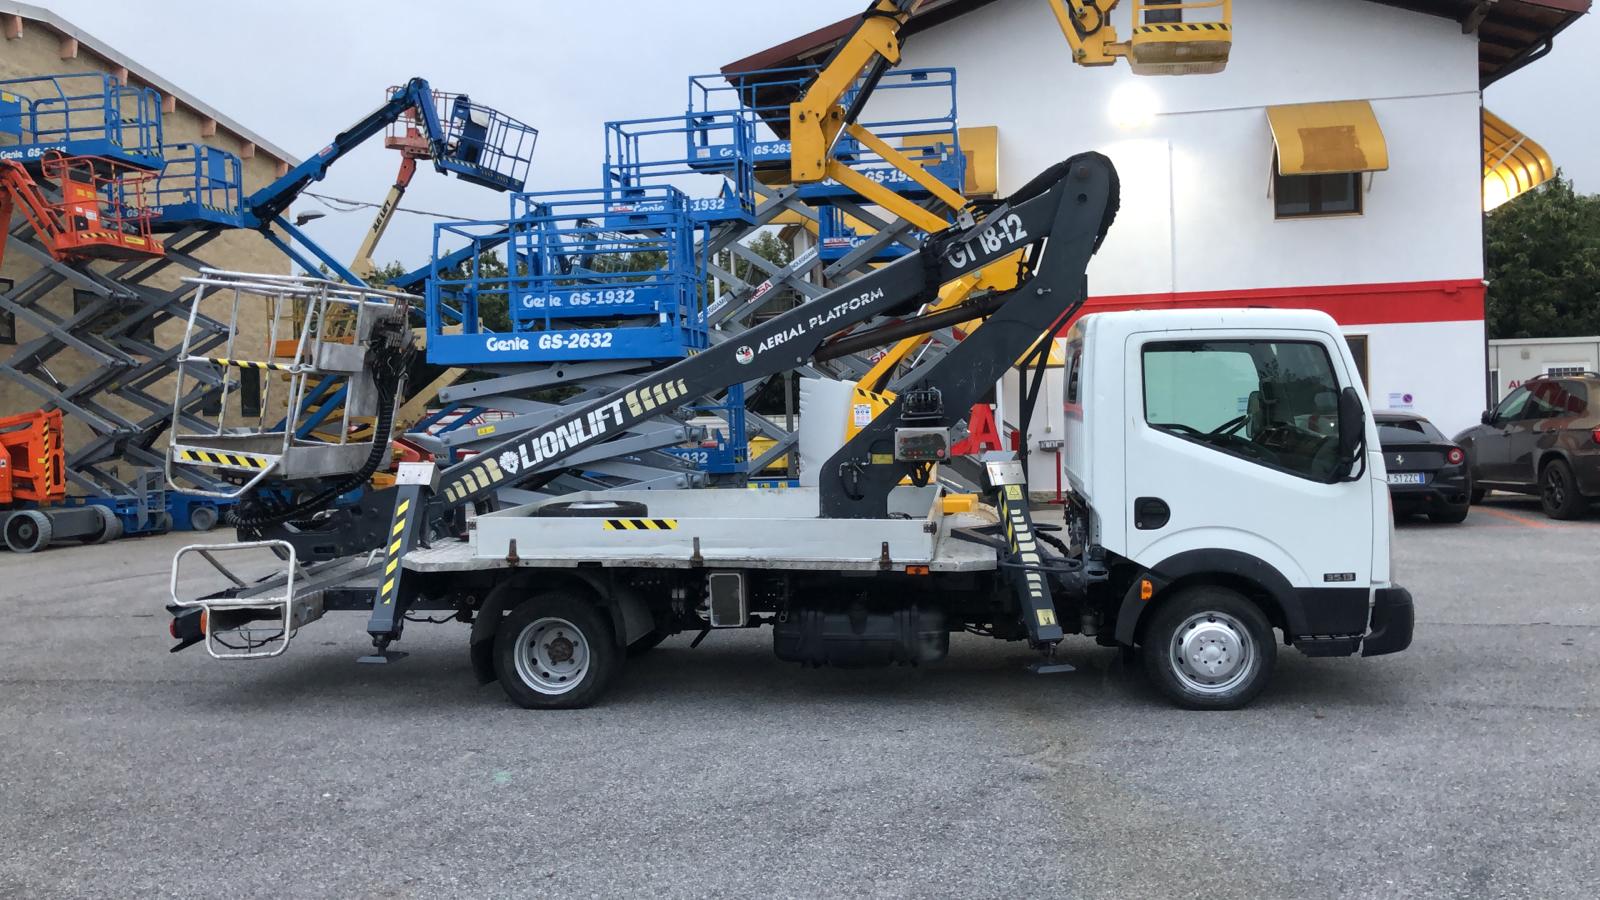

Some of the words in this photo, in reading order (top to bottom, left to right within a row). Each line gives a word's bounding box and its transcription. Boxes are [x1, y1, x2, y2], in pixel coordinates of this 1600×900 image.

[0, 149, 23, 160] Genie
[754, 143, 791, 155] GS-263
[977, 213, 1028, 255] 18-12
[569, 289, 635, 306] GS-1932
[757, 323, 806, 354] AERIAL
[808, 287, 884, 330] PLATFORM
[486, 337, 530, 351] Genie
[538, 332, 613, 350] GS-2632
[518, 397, 624, 469] LIONLIFT
